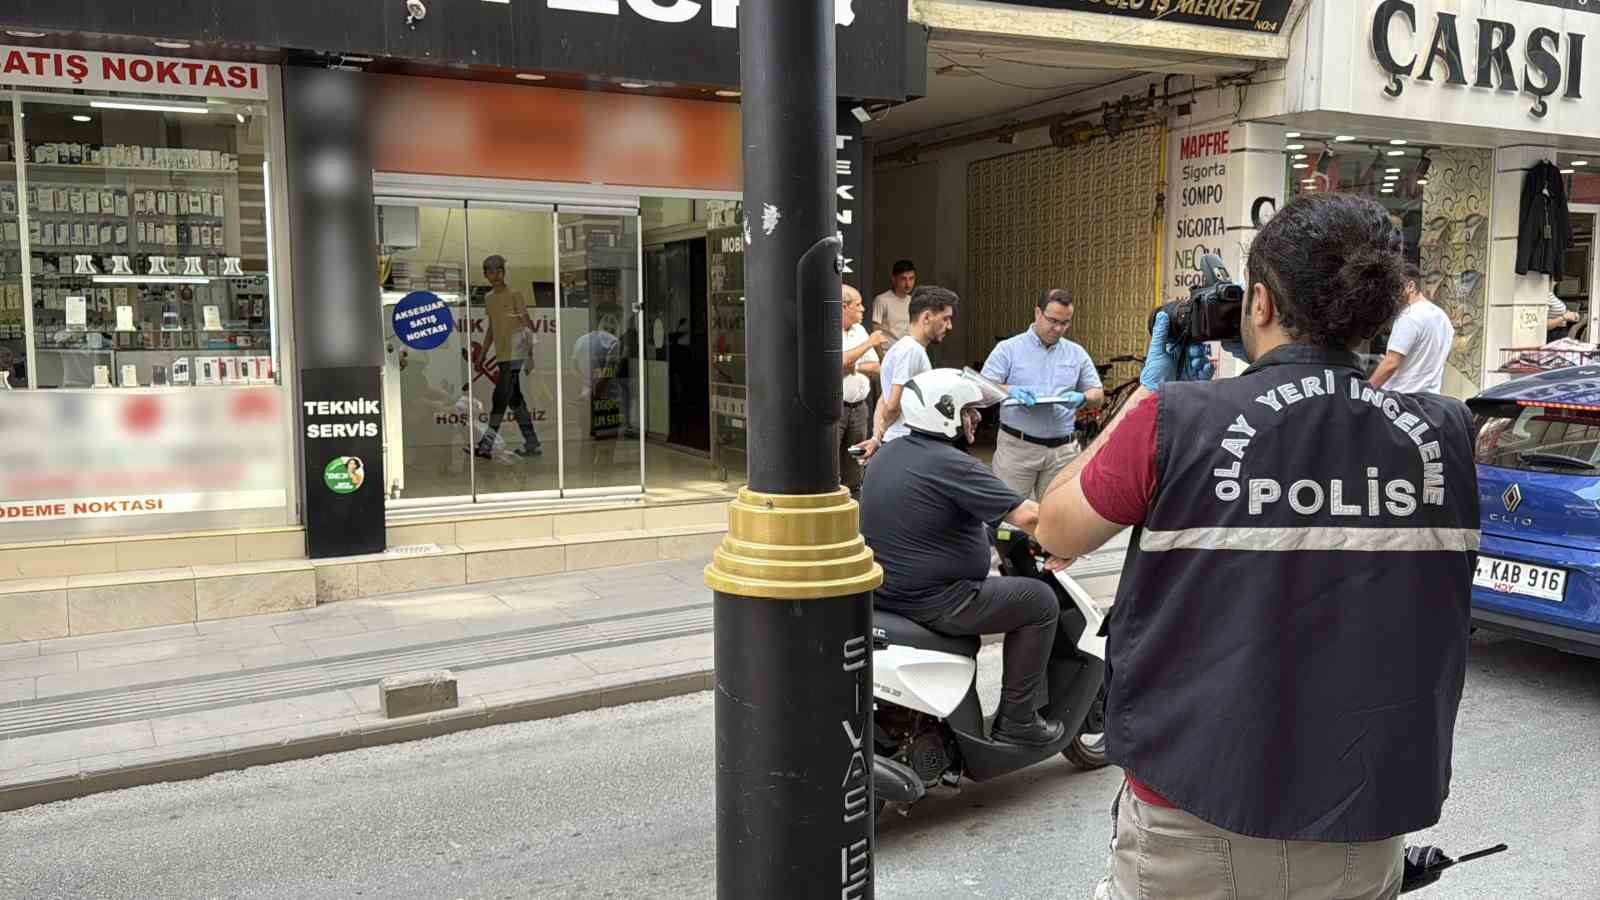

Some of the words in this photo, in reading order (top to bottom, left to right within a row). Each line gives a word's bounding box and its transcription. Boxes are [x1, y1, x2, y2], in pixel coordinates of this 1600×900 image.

[0, 50, 89, 84] ATIŞ
[102, 56, 258, 89] NOKTASI
[1372, 0, 1586, 118] ÇARŞI
[1180, 128, 1230, 160] MAPFRE
[1182, 162, 1226, 182] Sigorta
[1182, 184, 1223, 207] SOMPO
[1176, 215, 1225, 238] SİGORTA
[395, 301, 444, 320] AKSESUAR
[406, 323, 447, 341] NOKTASI
[410, 315, 436, 328] SATIŞ
[304, 397, 379, 415] TEKNİK
[307, 420, 378, 438] SERVİS
[1214, 414, 1256, 501] OLAY
[1248, 467, 1417, 516] POLİS
[73, 499, 163, 514] NOKTASI
[1489, 513, 1532, 526] CLIO
[1490, 561, 1522, 584] KAB
[1528, 568, 1560, 591] 916
